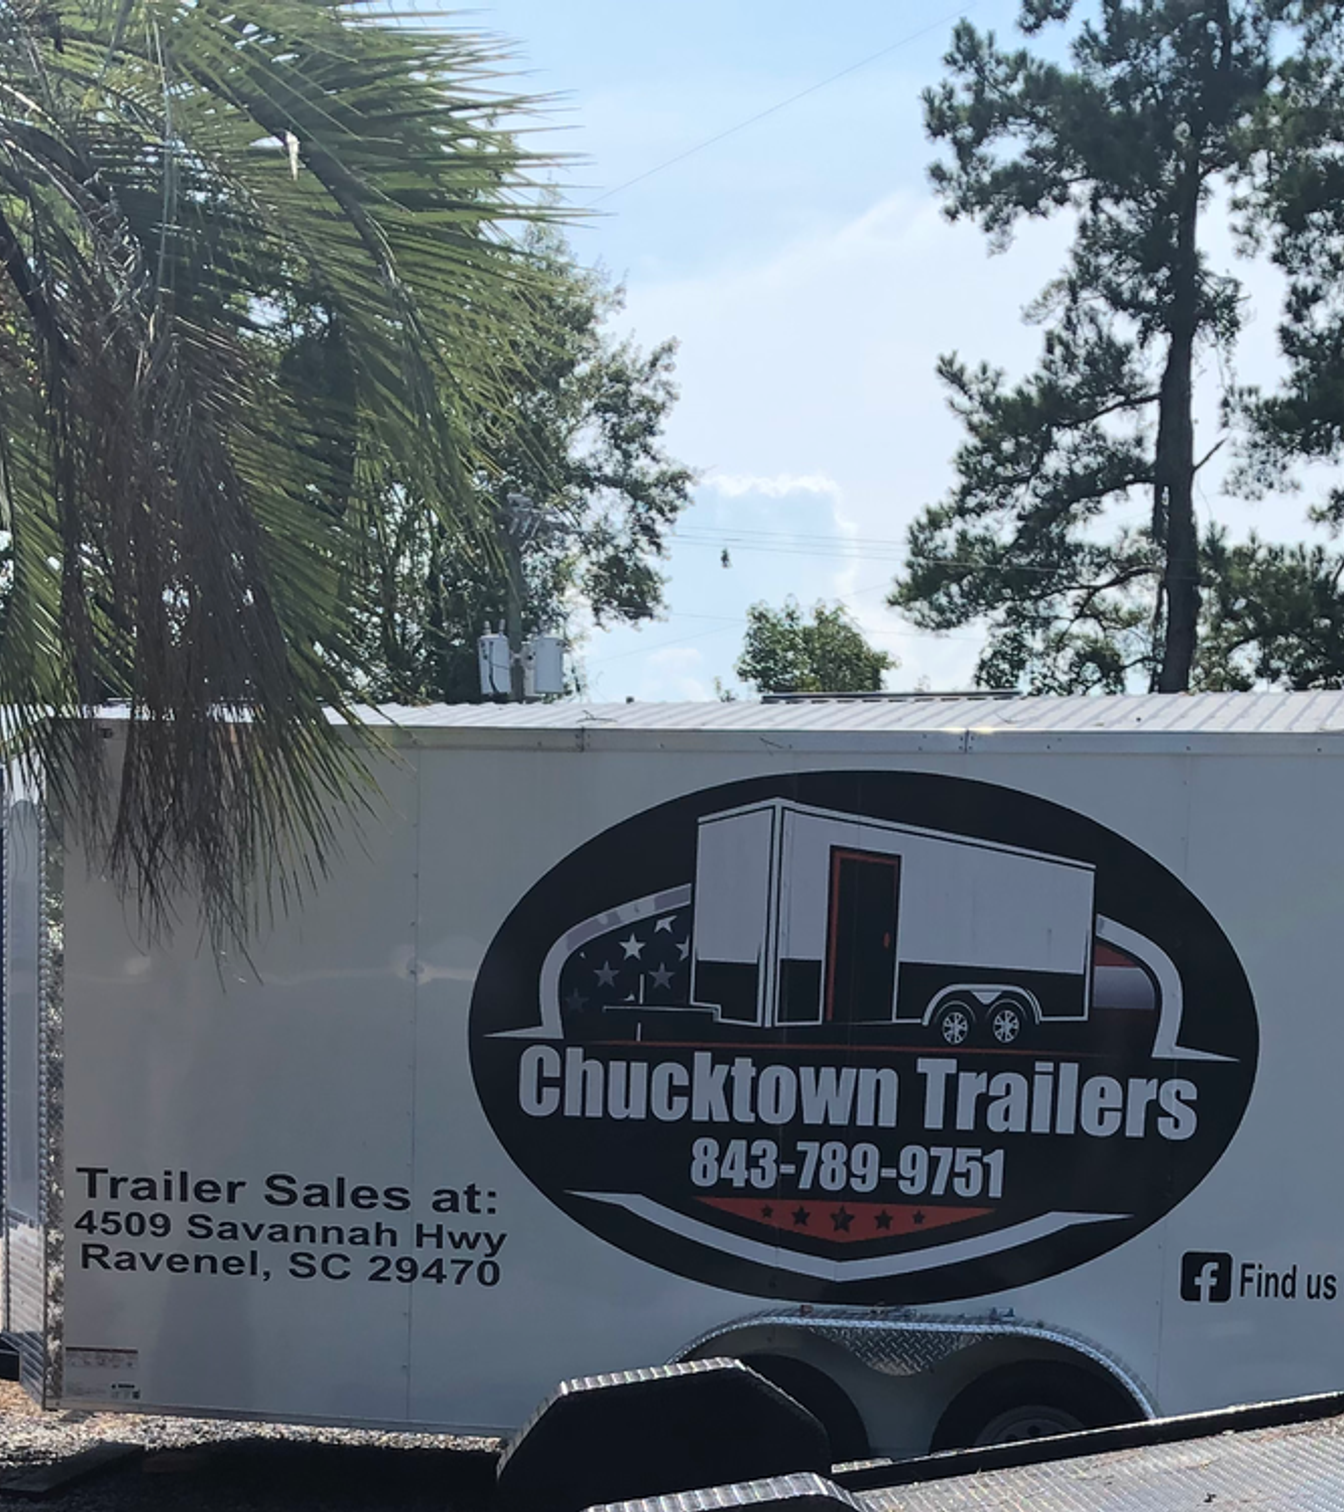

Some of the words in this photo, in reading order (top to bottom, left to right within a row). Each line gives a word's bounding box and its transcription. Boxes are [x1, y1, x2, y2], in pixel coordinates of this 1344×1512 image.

[517, 1044, 899, 1128] Chucktown
[916, 1057, 1199, 1141] Trailers
[75, 1167, 247, 1204] Trailer
[264, 1173, 411, 1211] Sales
[431, 1182, 498, 1215] at:
[690, 1137, 1005, 1199] 843-789-9751
[73, 1209, 171, 1238] 4509
[186, 1213, 398, 1248] Savannah
[415, 1223, 508, 1258] Hwy
[81, 1243, 271, 1282] Ravenel,
[288, 1251, 351, 1280] SC
[367, 1255, 500, 1287] 29470
[1239, 1262, 1297, 1299] Find
[1306, 1274, 1337, 1301] us
